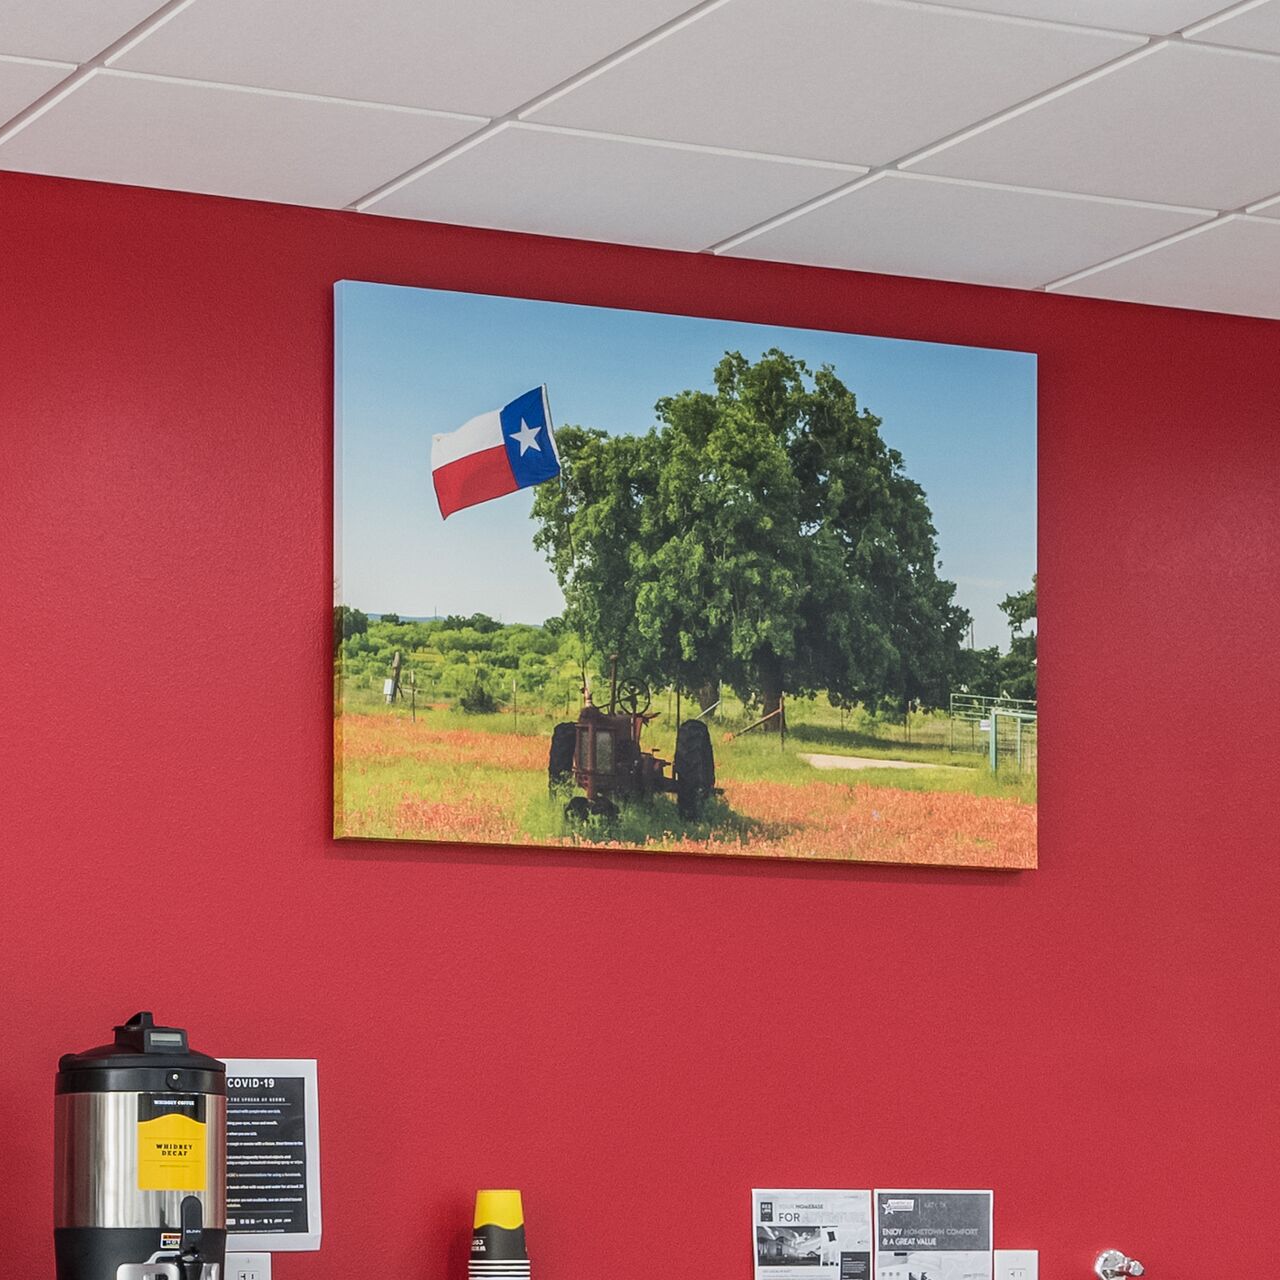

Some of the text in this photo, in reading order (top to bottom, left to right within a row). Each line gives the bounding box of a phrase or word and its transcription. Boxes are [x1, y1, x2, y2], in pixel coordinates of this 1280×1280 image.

[227, 1078, 275, 1088] COVID-19
[778, 1212, 800, 1222] FOR
[882, 1228, 903, 1236] ENJOY
